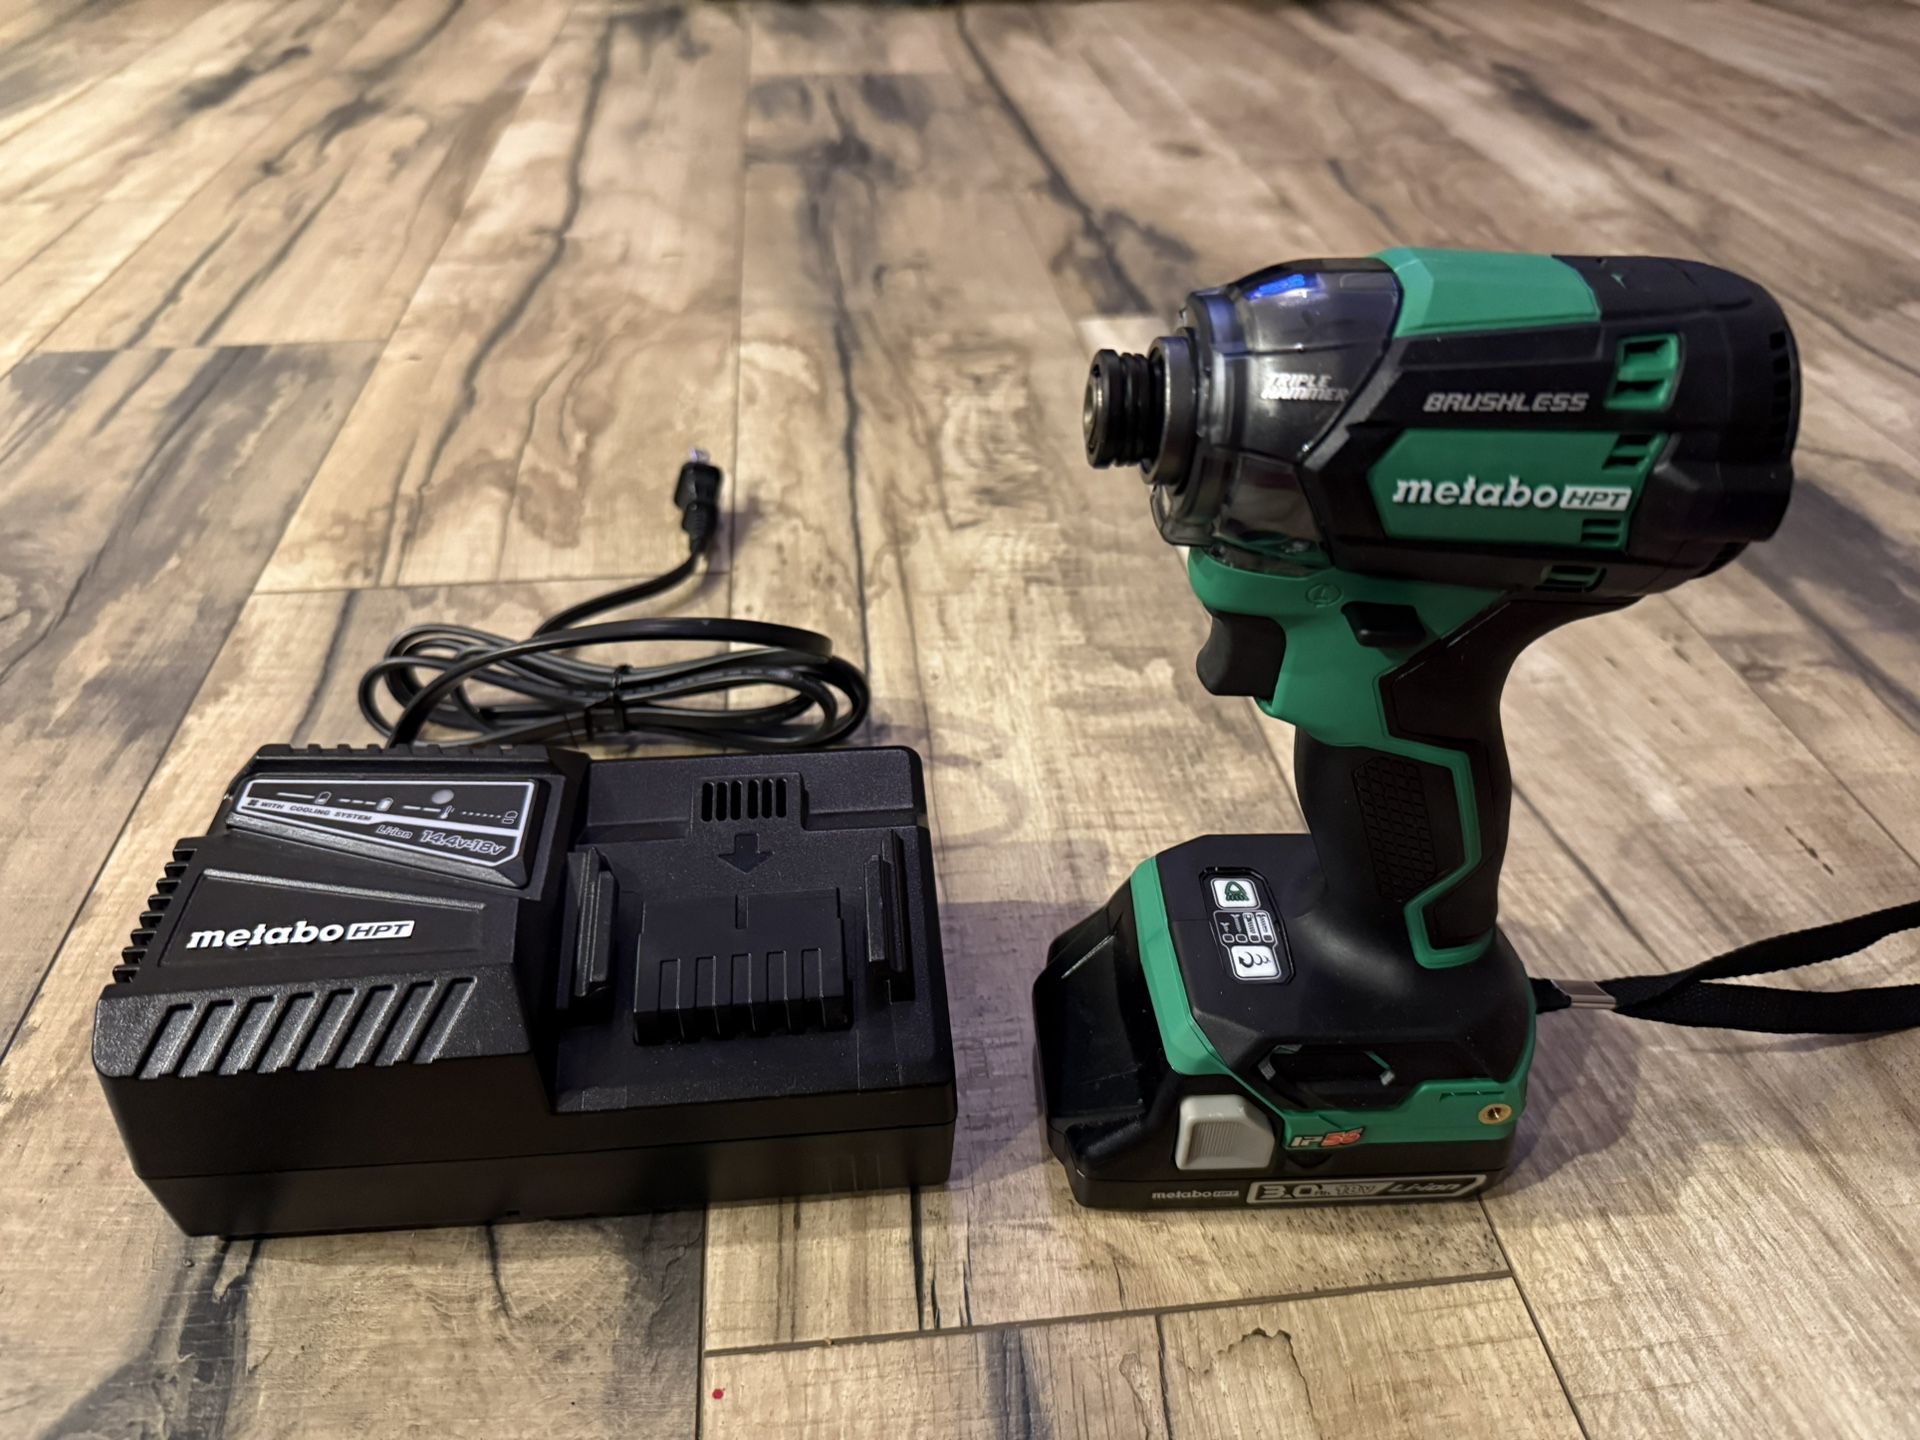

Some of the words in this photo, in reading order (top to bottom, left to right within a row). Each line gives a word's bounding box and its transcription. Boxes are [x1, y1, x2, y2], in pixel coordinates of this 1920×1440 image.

[1422, 391, 1590, 413] BRUSHLESS
[1392, 474, 1559, 509] metabo
[1563, 487, 1630, 510] HPT
[260, 801, 284, 810] WITH
[289, 805, 331, 816] COOLING
[334, 811, 373, 821] SYSTEM
[186, 920, 344, 949] metabo
[350, 922, 413, 939] HPT
[1152, 1189, 1212, 1199] metabo
